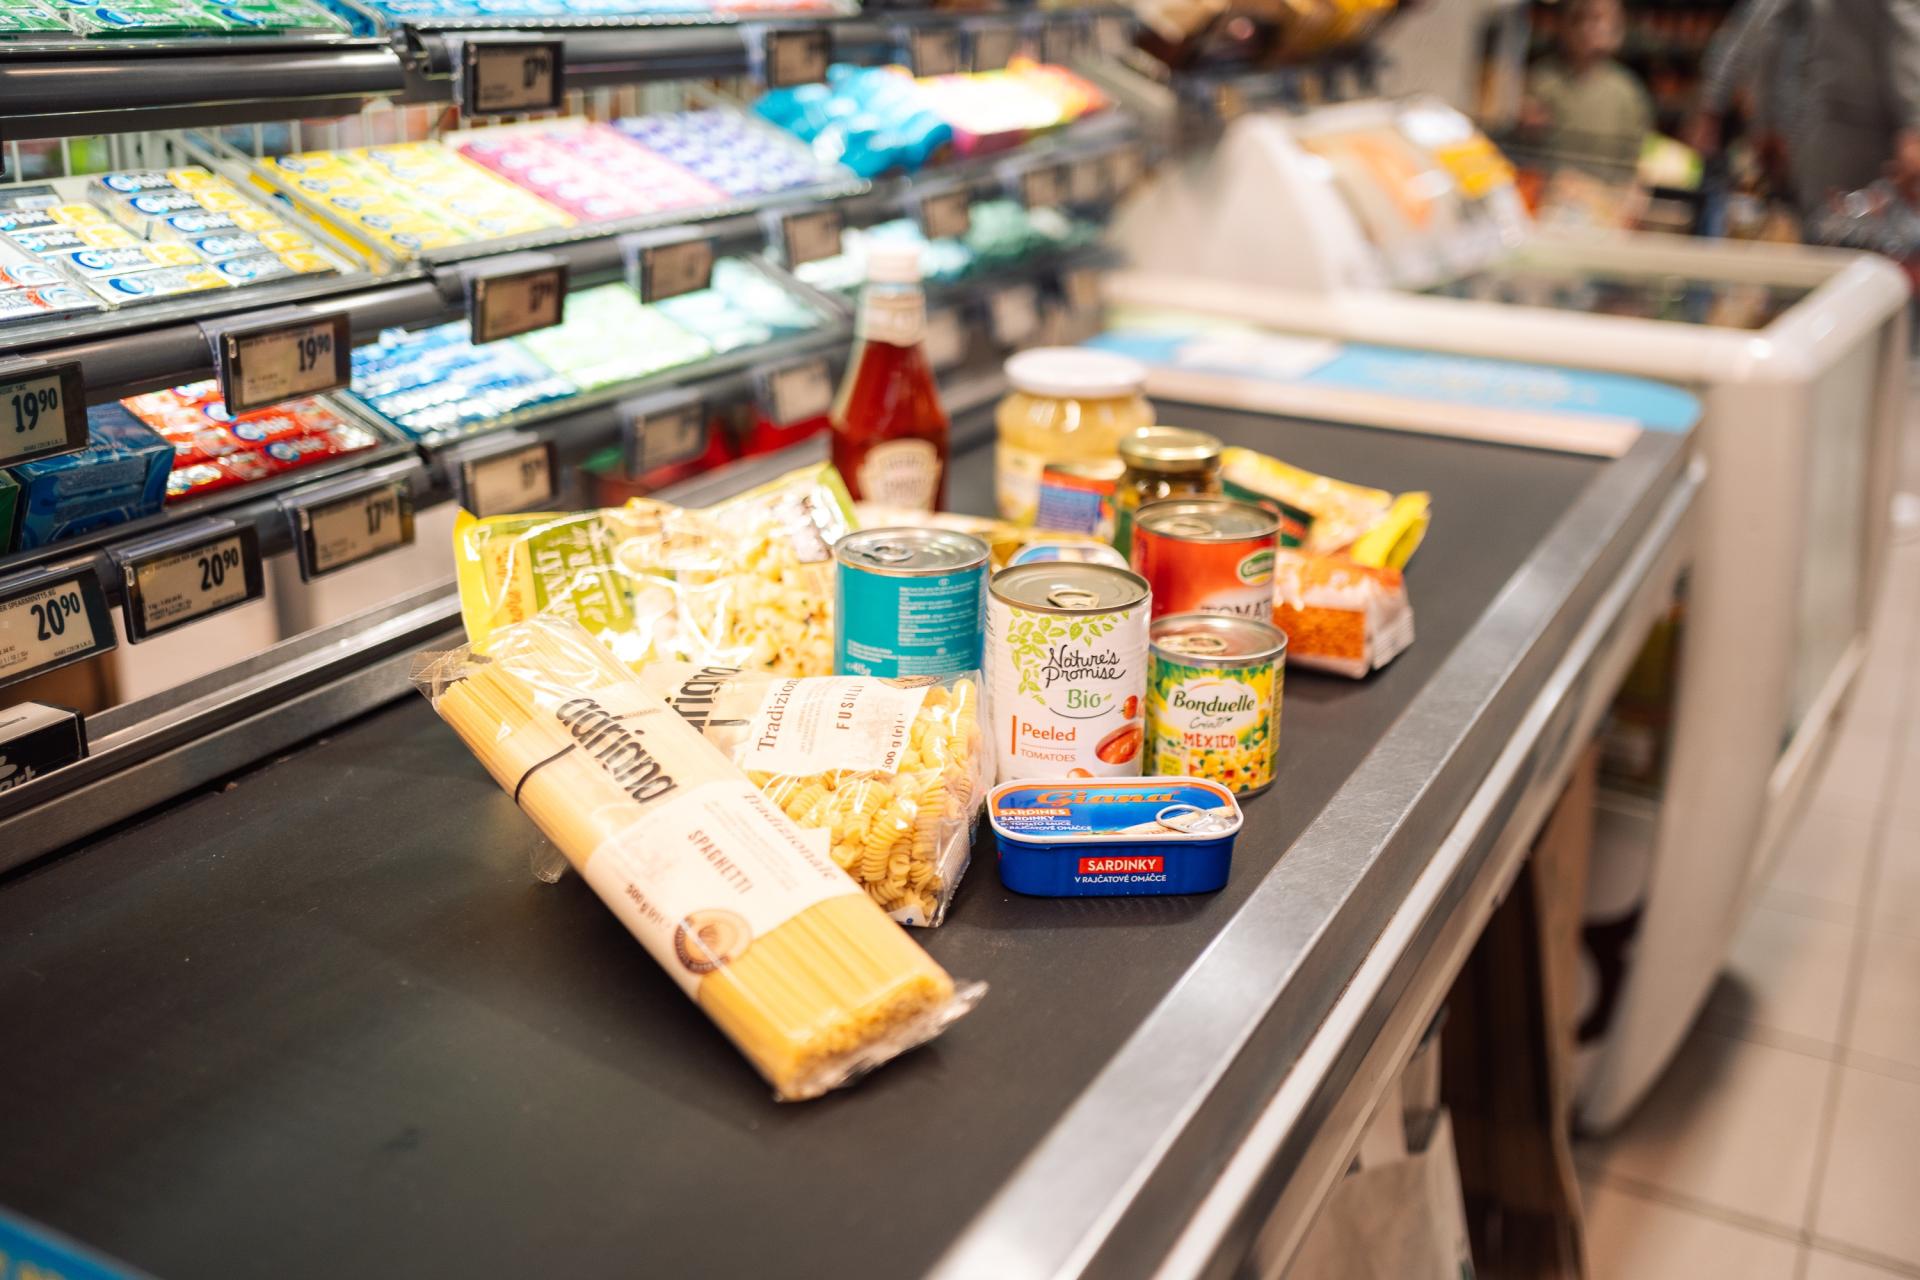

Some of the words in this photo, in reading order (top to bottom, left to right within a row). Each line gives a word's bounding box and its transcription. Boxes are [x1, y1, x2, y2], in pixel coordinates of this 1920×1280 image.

[11, 387, 58, 433] 1990
[198, 547, 239, 591] 2090
[30, 591, 80, 641] 2090
[1045, 644, 1120, 669] Nature's
[1041, 665, 1127, 689] Promise
[1066, 688, 1101, 709] Bio
[1173, 690, 1255, 718] Bonduelle
[757, 678, 801, 752] Tradizion
[1022, 722, 1076, 742] Peeled
[1183, 732, 1237, 749] MEXICO
[556, 698, 678, 804] adriana
[1020, 748, 1076, 762] TOMATOES
[1000, 808, 1067, 816] SARDINES
[1000, 815, 1055, 823] SARDINKY
[688, 829, 753, 895] SPAGHETTI
[1087, 859, 1156, 872] SARDINKY
[1082, 873, 1130, 884] RAJČATOVÉ
[1131, 872, 1167, 883] OMÁČCE
